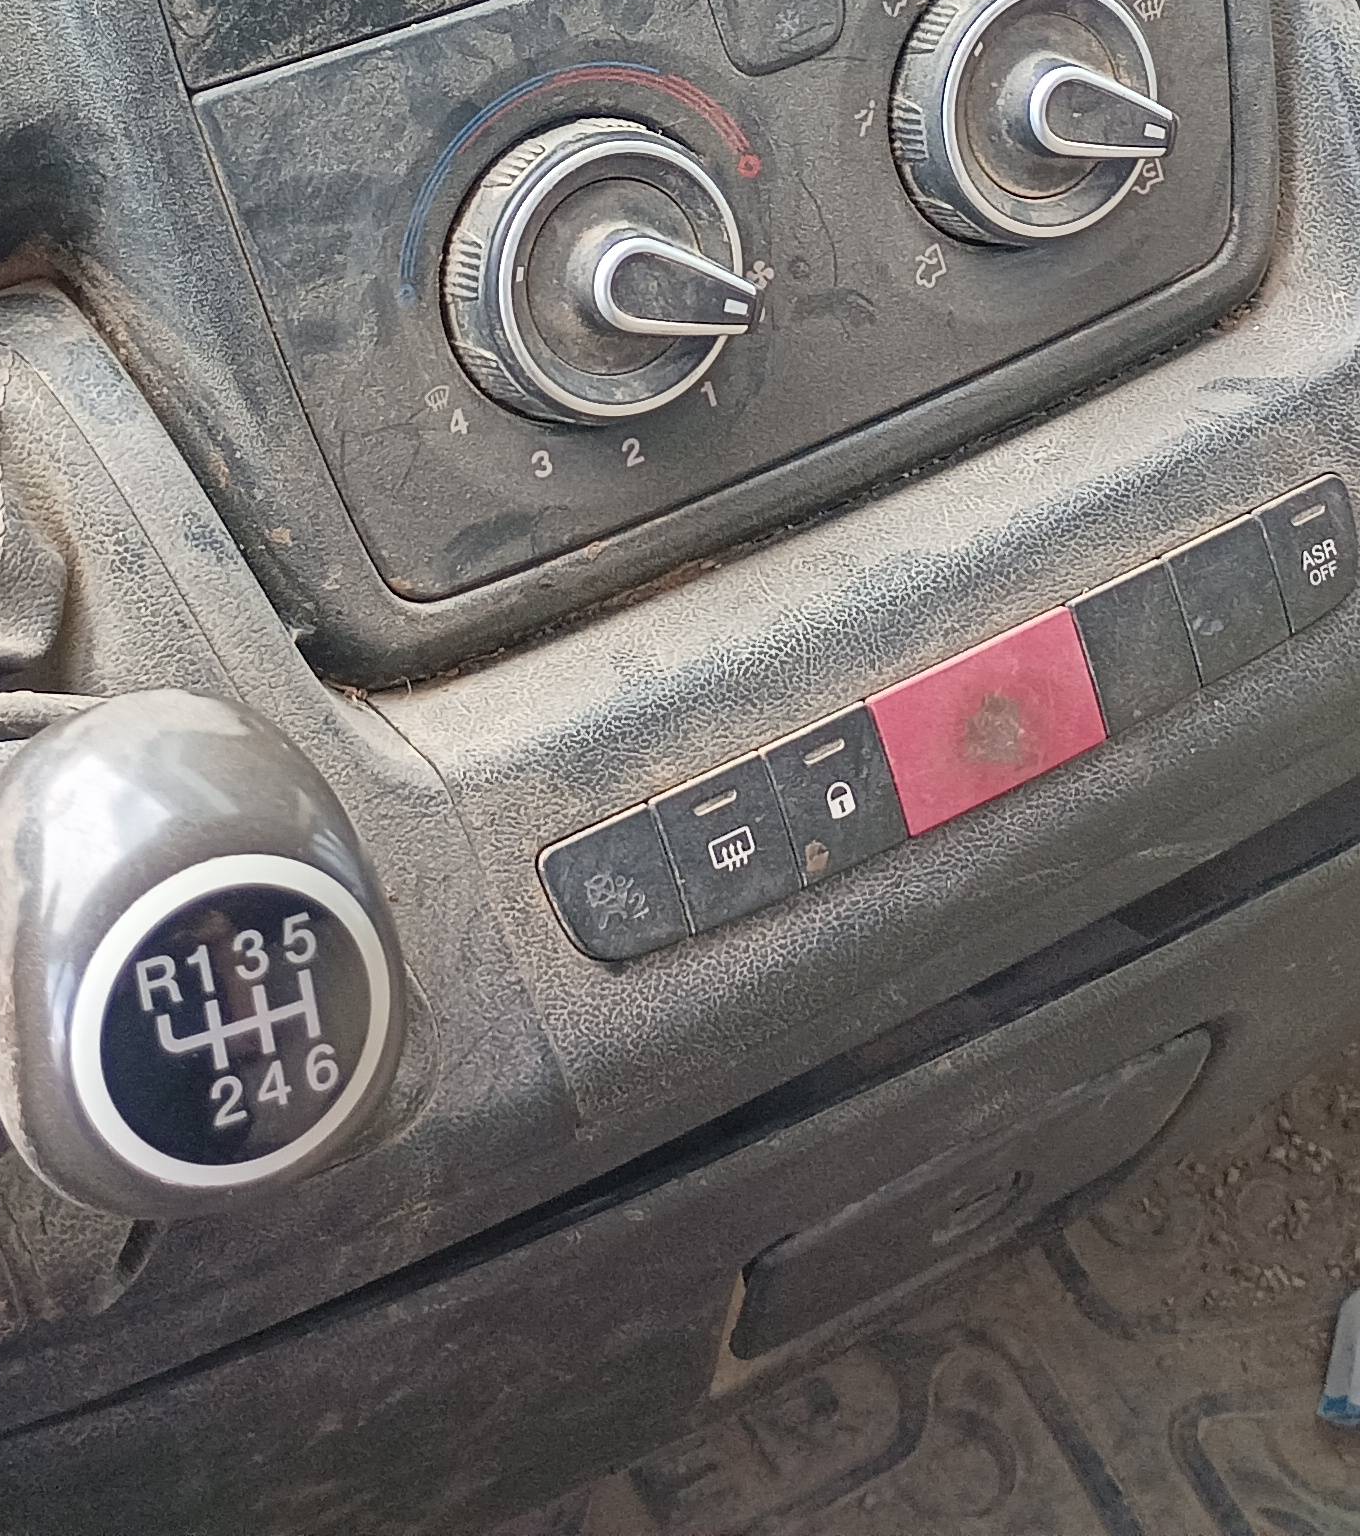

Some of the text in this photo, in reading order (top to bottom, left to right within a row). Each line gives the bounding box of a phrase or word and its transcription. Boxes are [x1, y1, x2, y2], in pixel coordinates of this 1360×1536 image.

[699, 379, 718, 407] 1
[449, 407, 469, 435] 4
[531, 449, 554, 478] 3
[621, 436, 646, 467] 2
[1301, 538, 1338, 572] ASR
[1308, 564, 1338, 586] OFF
[136, 912, 317, 1012] R 1 3 5
[210, 1043, 340, 1128] 2 4 6
